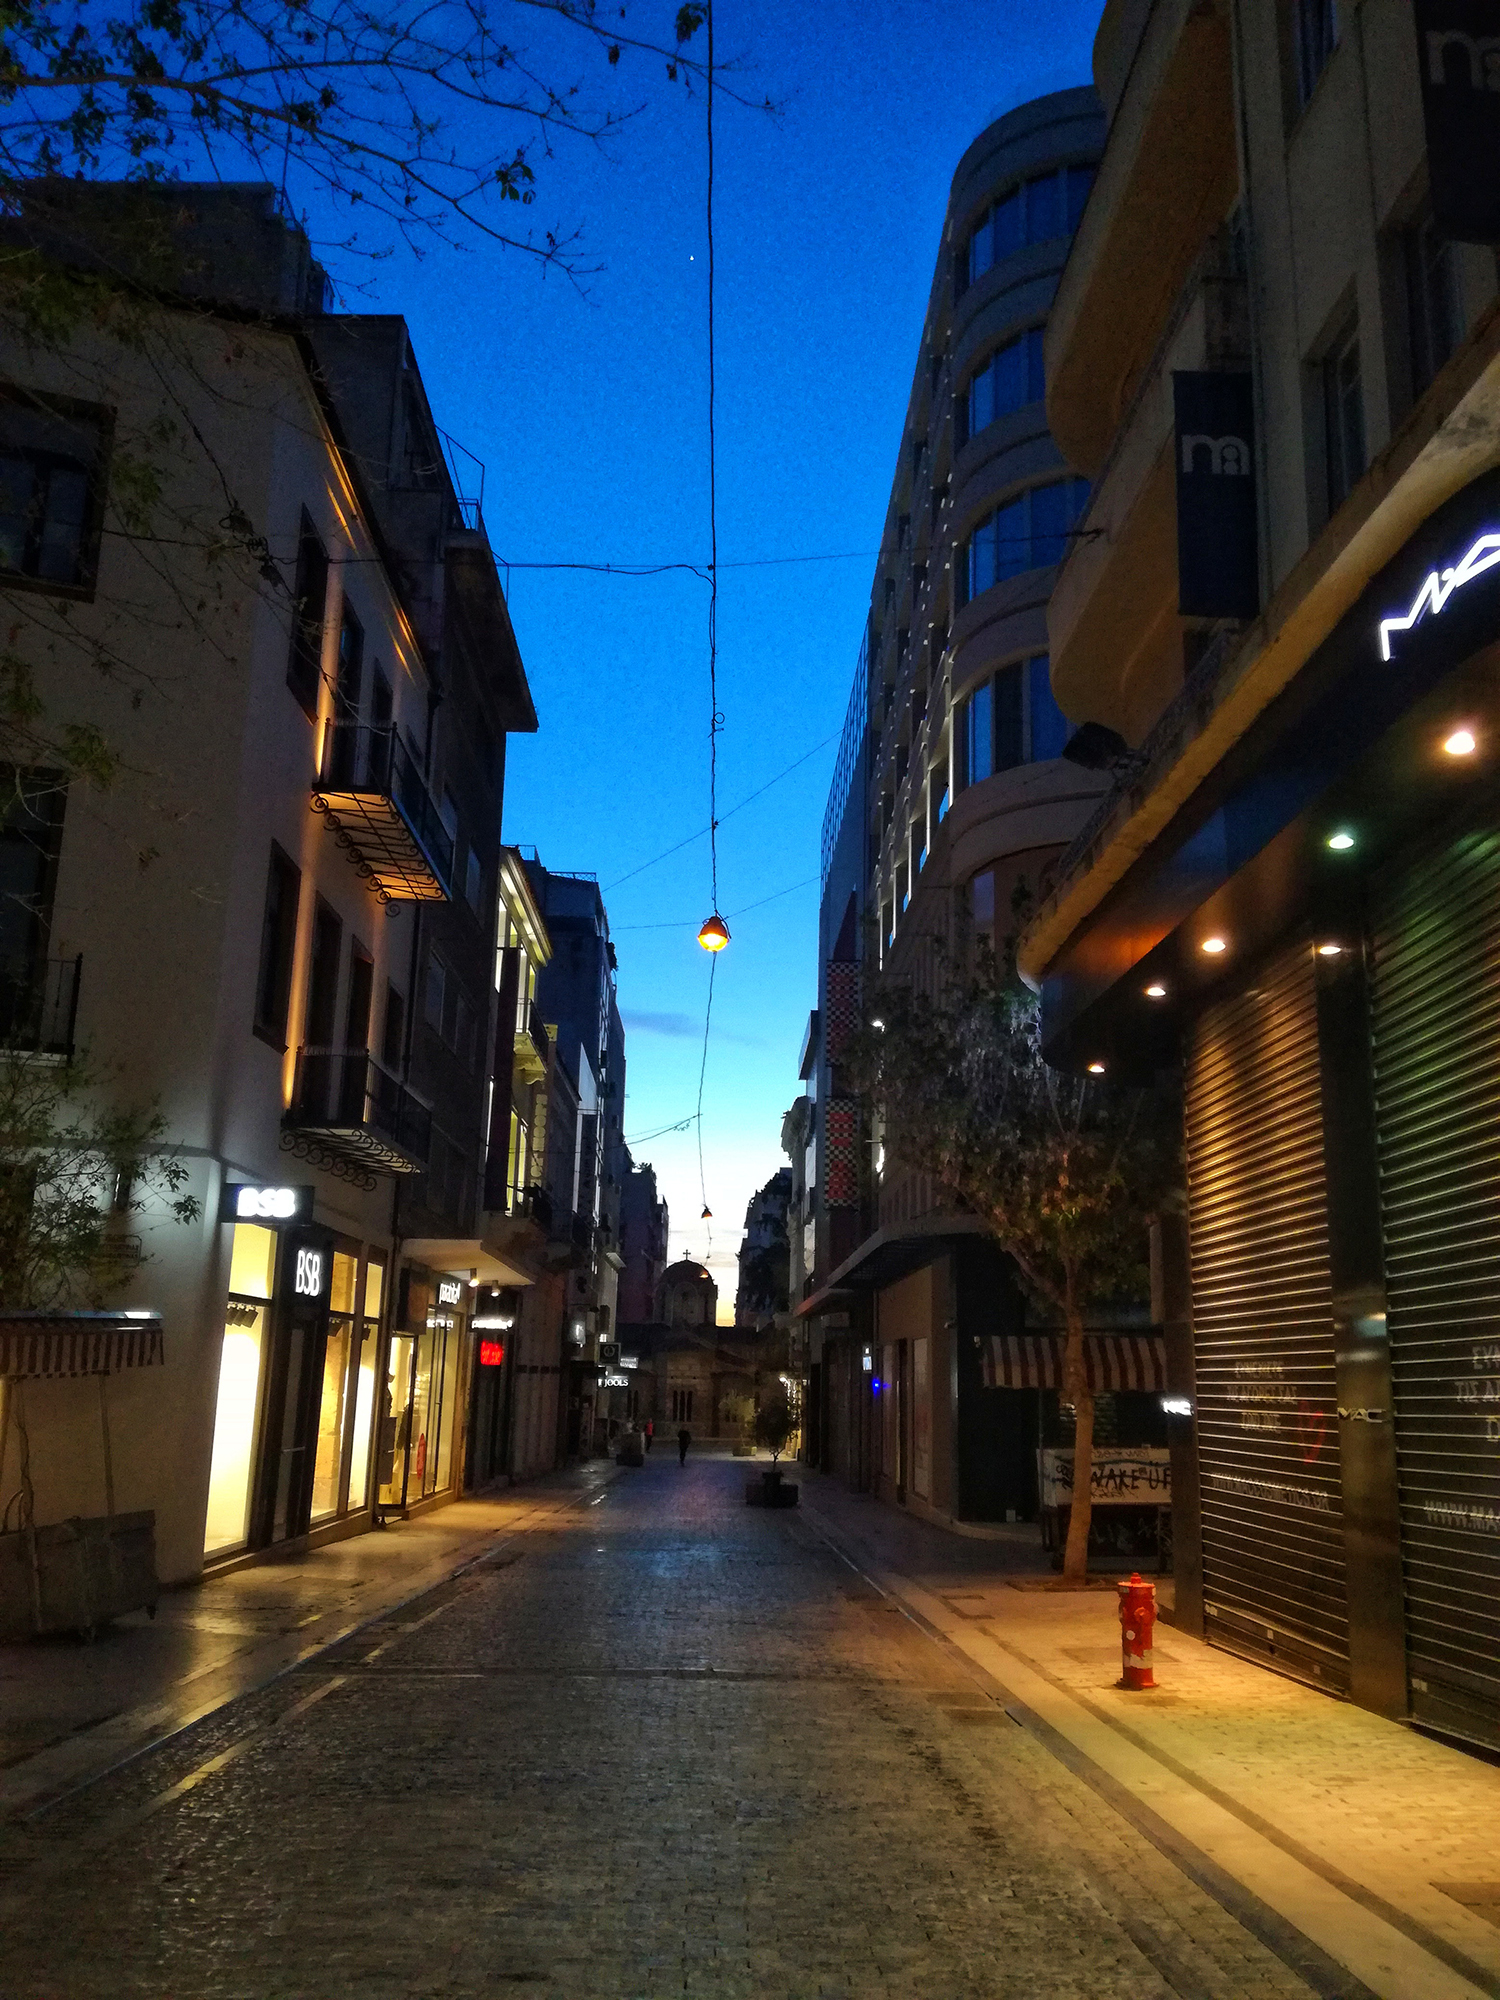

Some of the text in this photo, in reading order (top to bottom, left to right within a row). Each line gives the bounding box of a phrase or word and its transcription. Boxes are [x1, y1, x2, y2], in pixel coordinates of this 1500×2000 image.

[237, 1188, 295, 1217] BSB
[295, 1249, 320, 1297] BSB
[1337, 1407, 1386, 1423] MAC
[1424, 1500, 1500, 1533] WWW.MA
